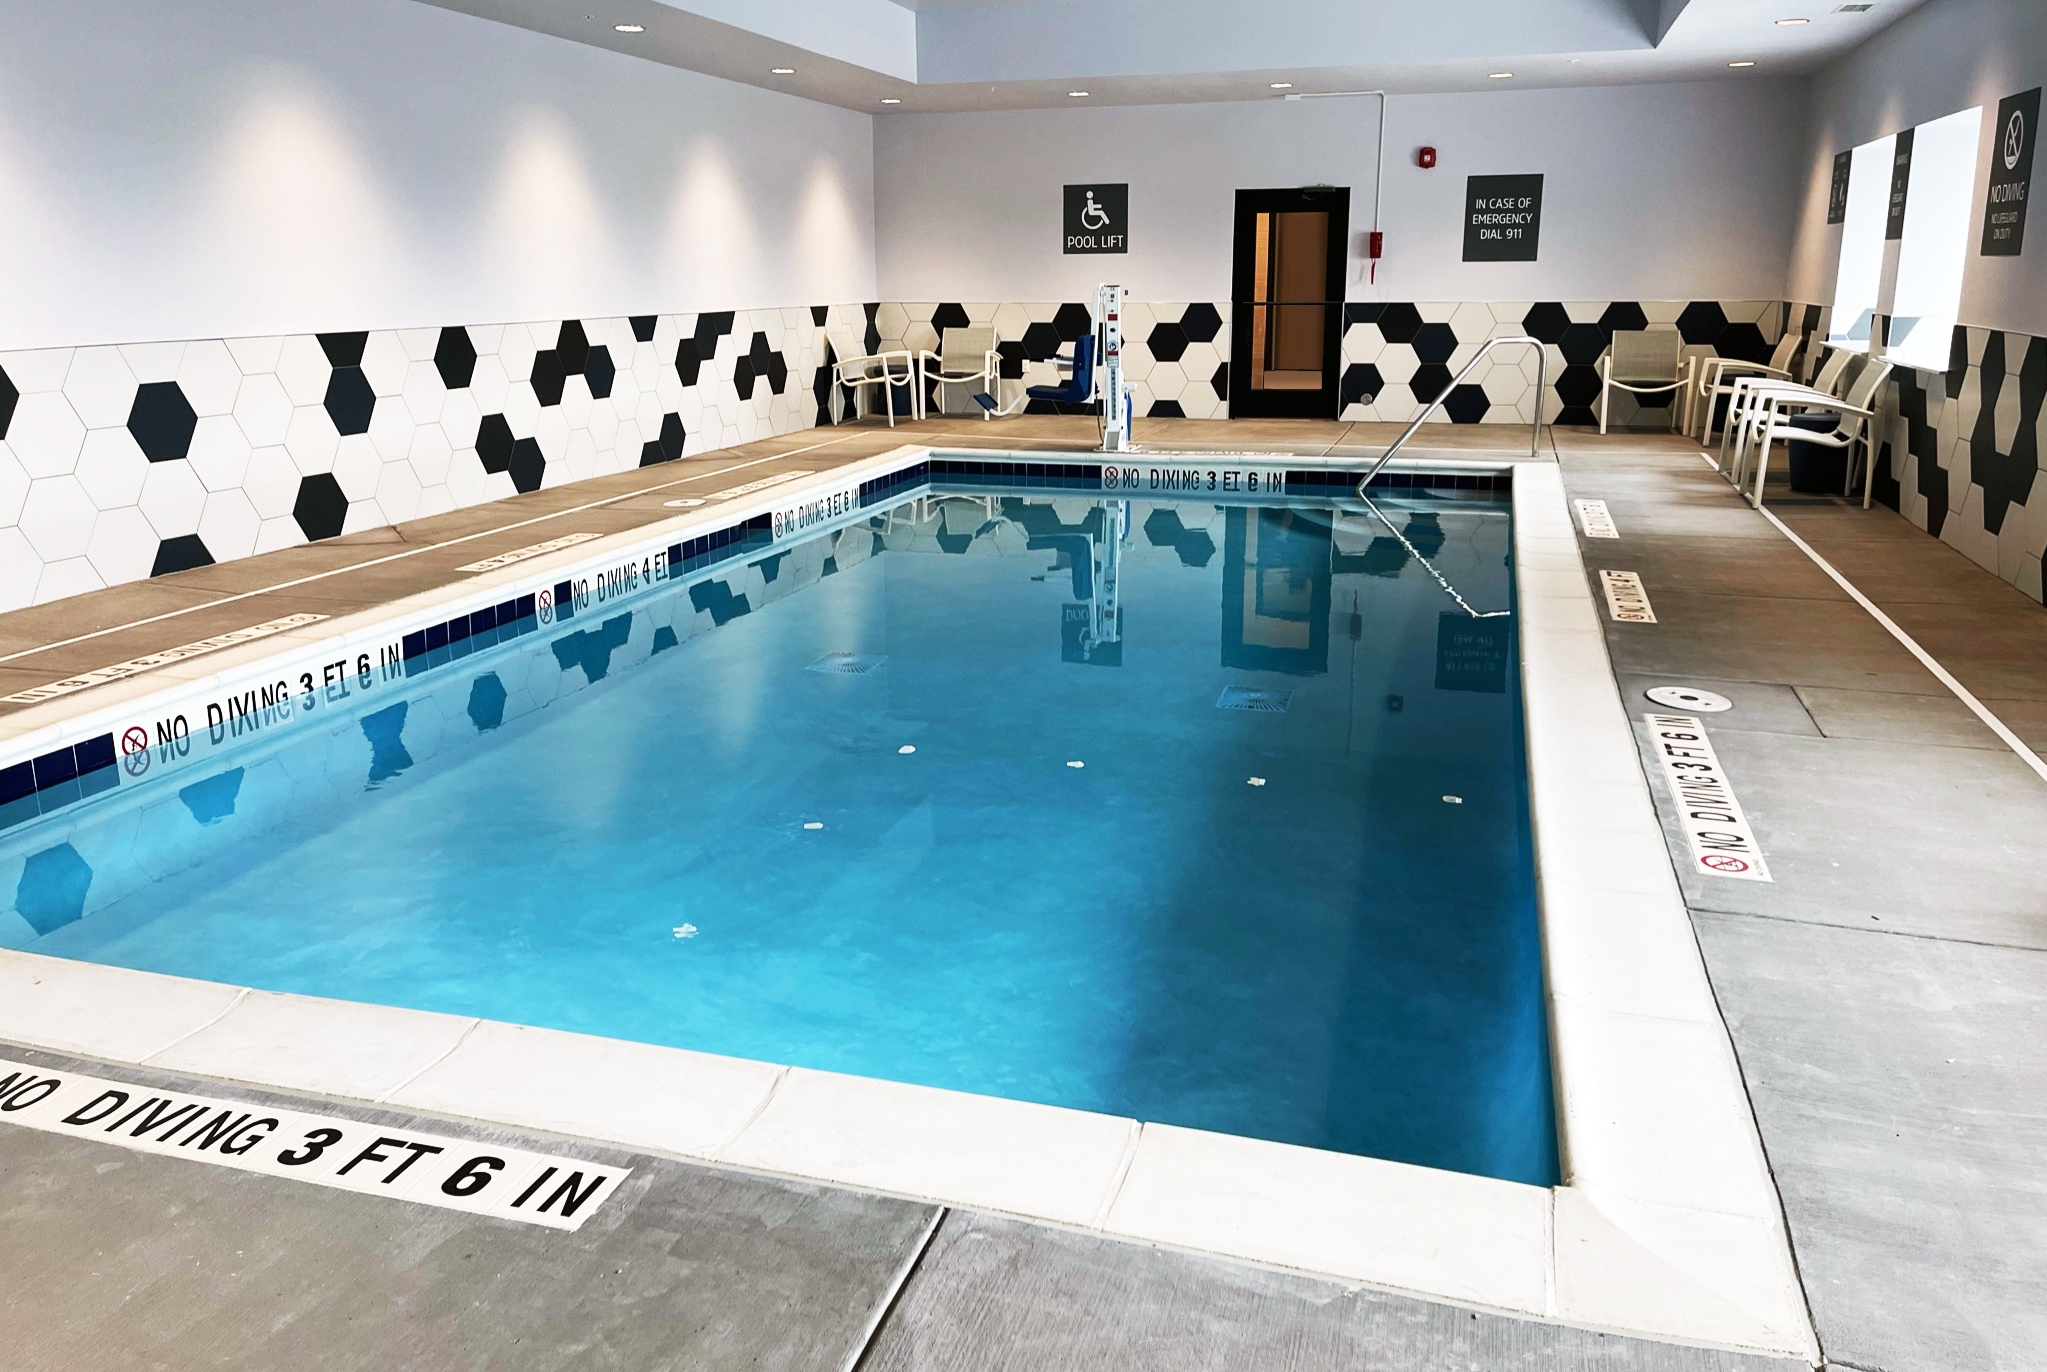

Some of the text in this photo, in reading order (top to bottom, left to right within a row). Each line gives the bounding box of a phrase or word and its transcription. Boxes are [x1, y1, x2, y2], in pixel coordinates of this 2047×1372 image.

[1990, 181, 2025, 203] NO DIVING
[1475, 197, 1533, 209] IN CASE OF
[1472, 212, 1534, 224] EMERGENCY
[1067, 235, 1124, 249] POOL LIFT
[1480, 228, 1523, 240] DIAL 911
[1122, 468, 1140, 485] NO
[1206, 470, 1217, 487] 3
[1266, 472, 1283, 489] IN
[573, 578, 589, 606] NO
[156, 714, 192, 756] NO
[299, 672, 316, 703] 3
[357, 653, 372, 684] 6
[380, 643, 401, 676] IN
[1654, 715, 1750, 853] NO DIVING 3 FT 6 IN
[60, 1088, 280, 1156] DIVING
[277, 1127, 344, 1167] 3
[335, 1136, 446, 1185] FT
[441, 1155, 506, 1198] 6
[510, 1166, 608, 1218] IN
